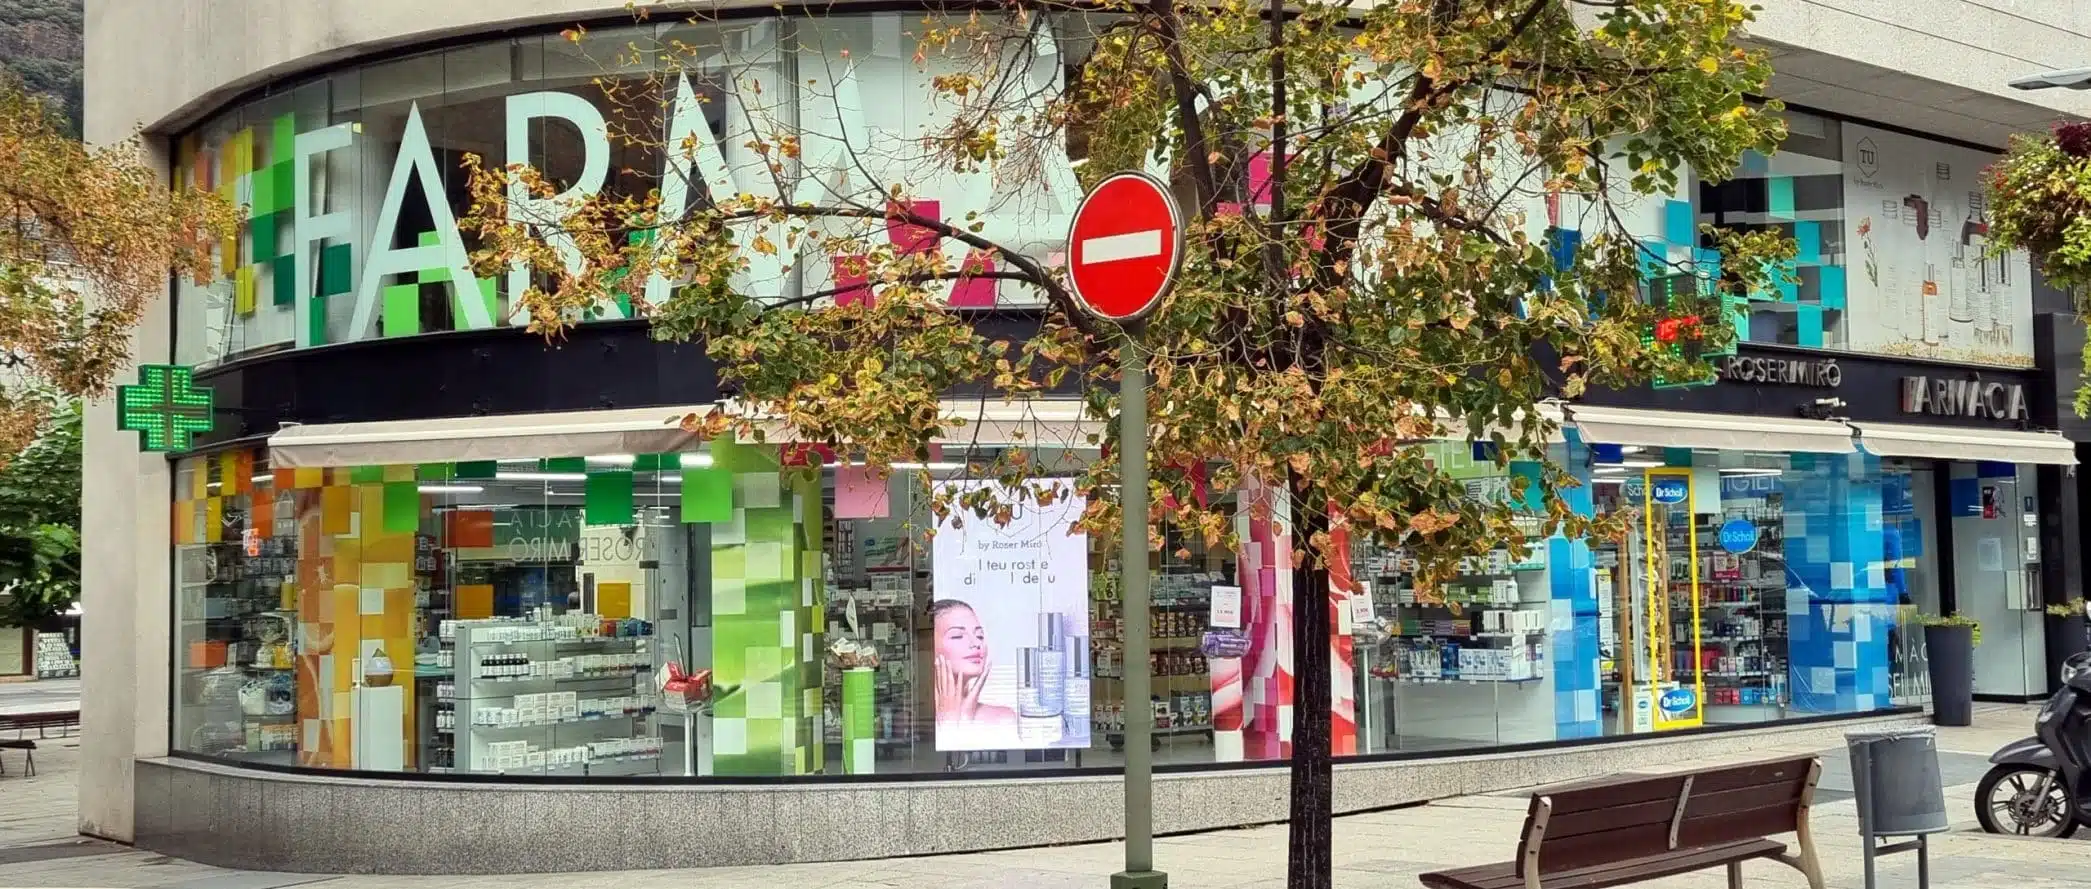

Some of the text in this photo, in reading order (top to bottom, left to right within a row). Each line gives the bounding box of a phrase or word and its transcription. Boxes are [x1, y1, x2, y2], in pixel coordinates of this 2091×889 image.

[1859, 149, 1875, 165] TU
[978, 540, 990, 552] by
[992, 540, 1018, 549] Roser
[986, 559, 1007, 571] teu
